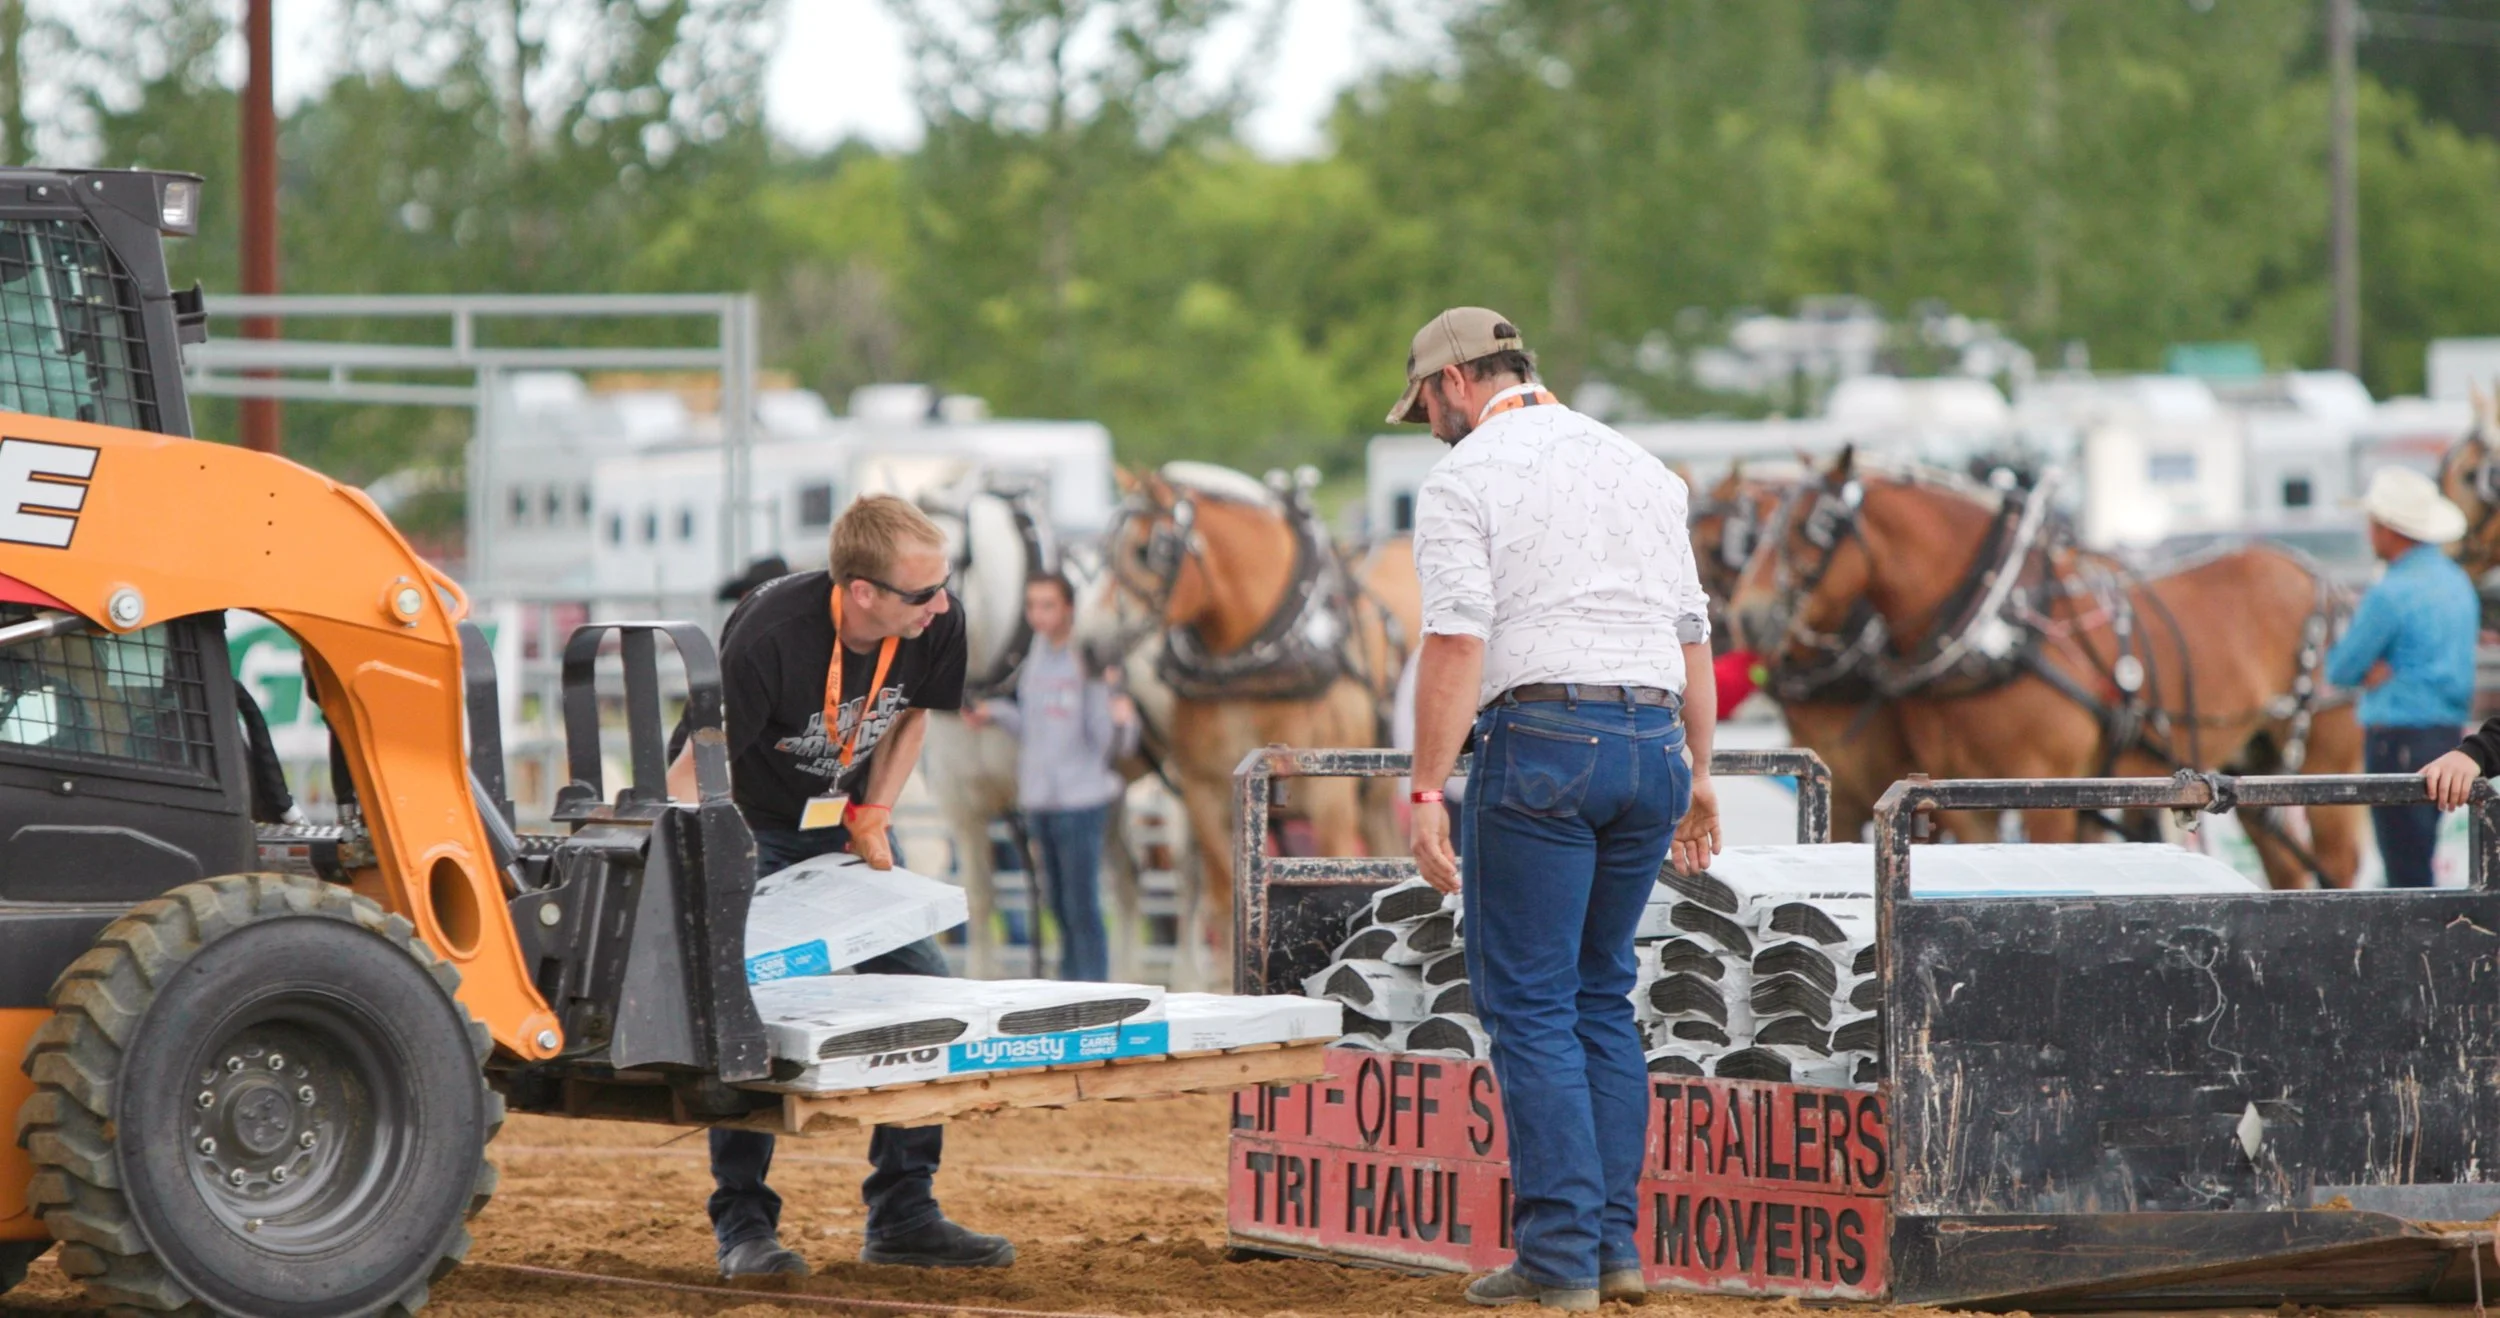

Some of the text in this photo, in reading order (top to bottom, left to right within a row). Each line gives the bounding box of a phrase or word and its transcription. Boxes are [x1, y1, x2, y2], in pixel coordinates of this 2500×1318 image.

[966, 1036, 1064, 1064] Dynasty
[1655, 1083, 1887, 1190] TRAILERS
[1246, 1151, 1321, 1228] TRI
[1346, 1161, 1472, 1244] HAUL
[1654, 1192, 1866, 1286] MOVERS
